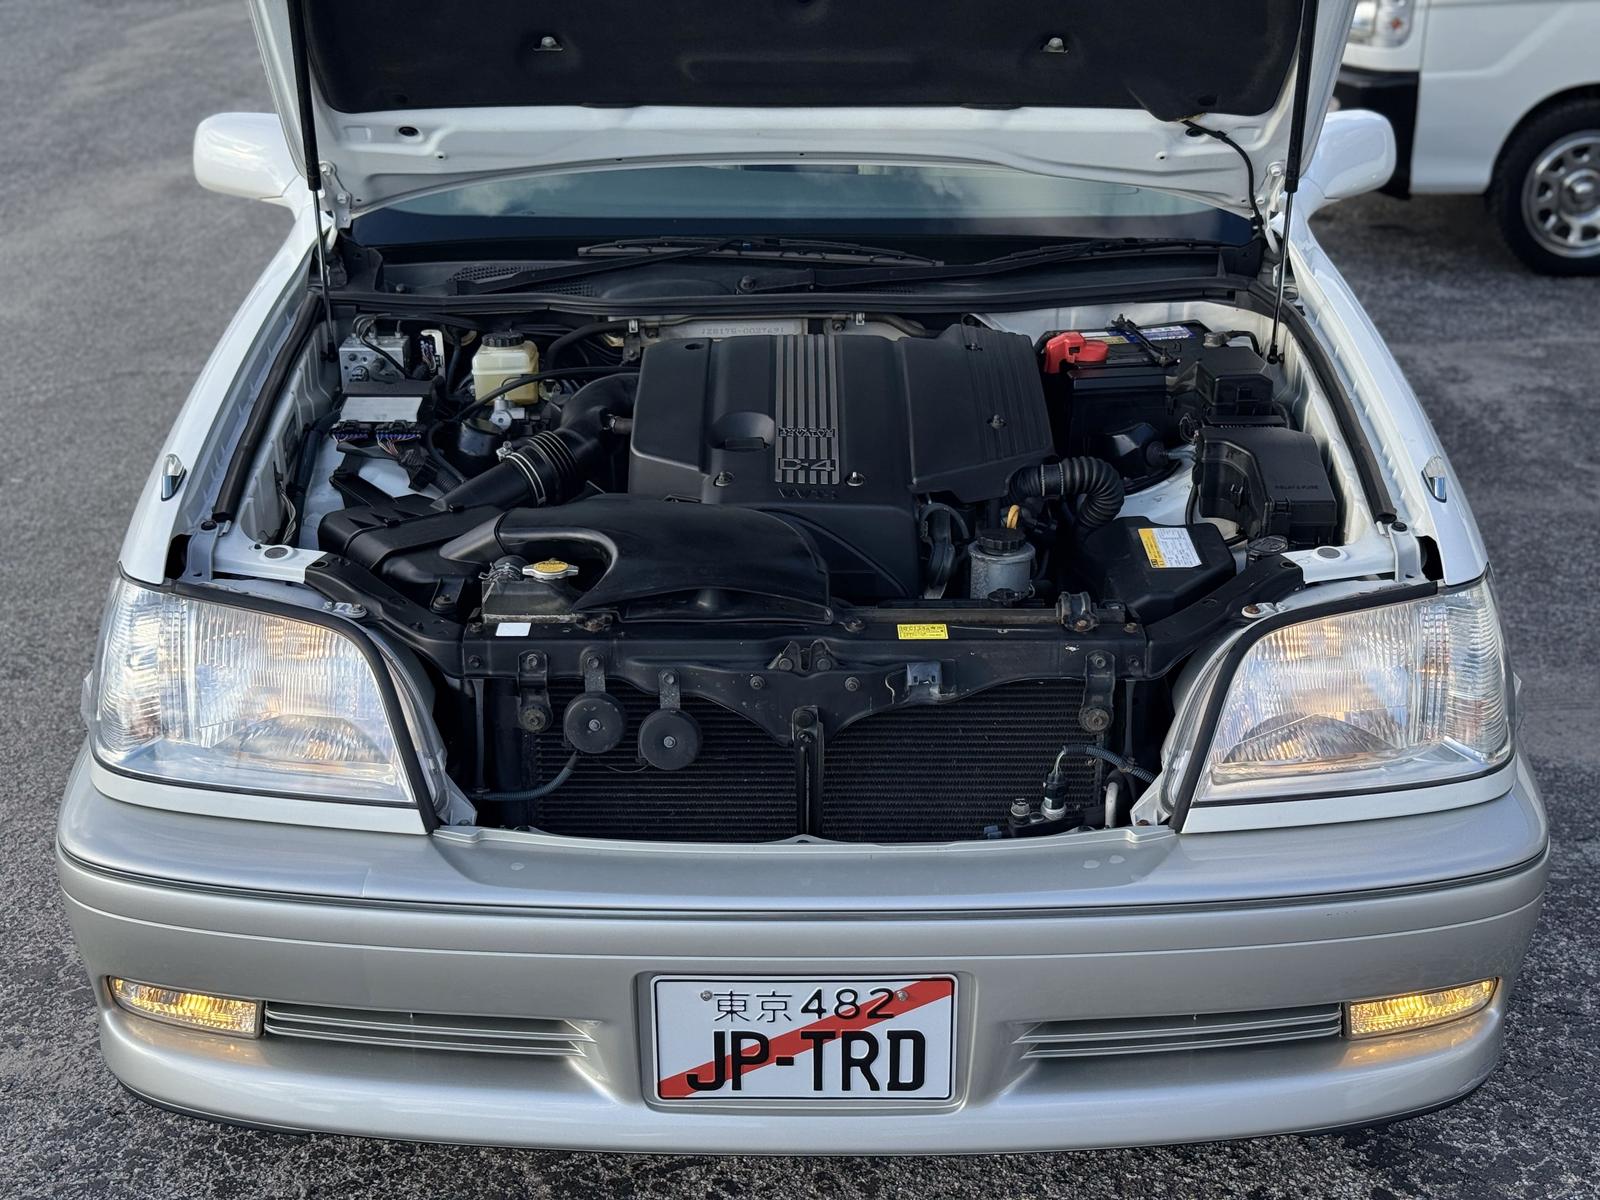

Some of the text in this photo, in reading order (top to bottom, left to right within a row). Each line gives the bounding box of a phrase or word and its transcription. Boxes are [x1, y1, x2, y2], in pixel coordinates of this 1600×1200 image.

[779, 458, 835, 471] D-4
[712, 987, 895, 1023] 東京 482
[686, 1030, 926, 1092] JP-TRD
